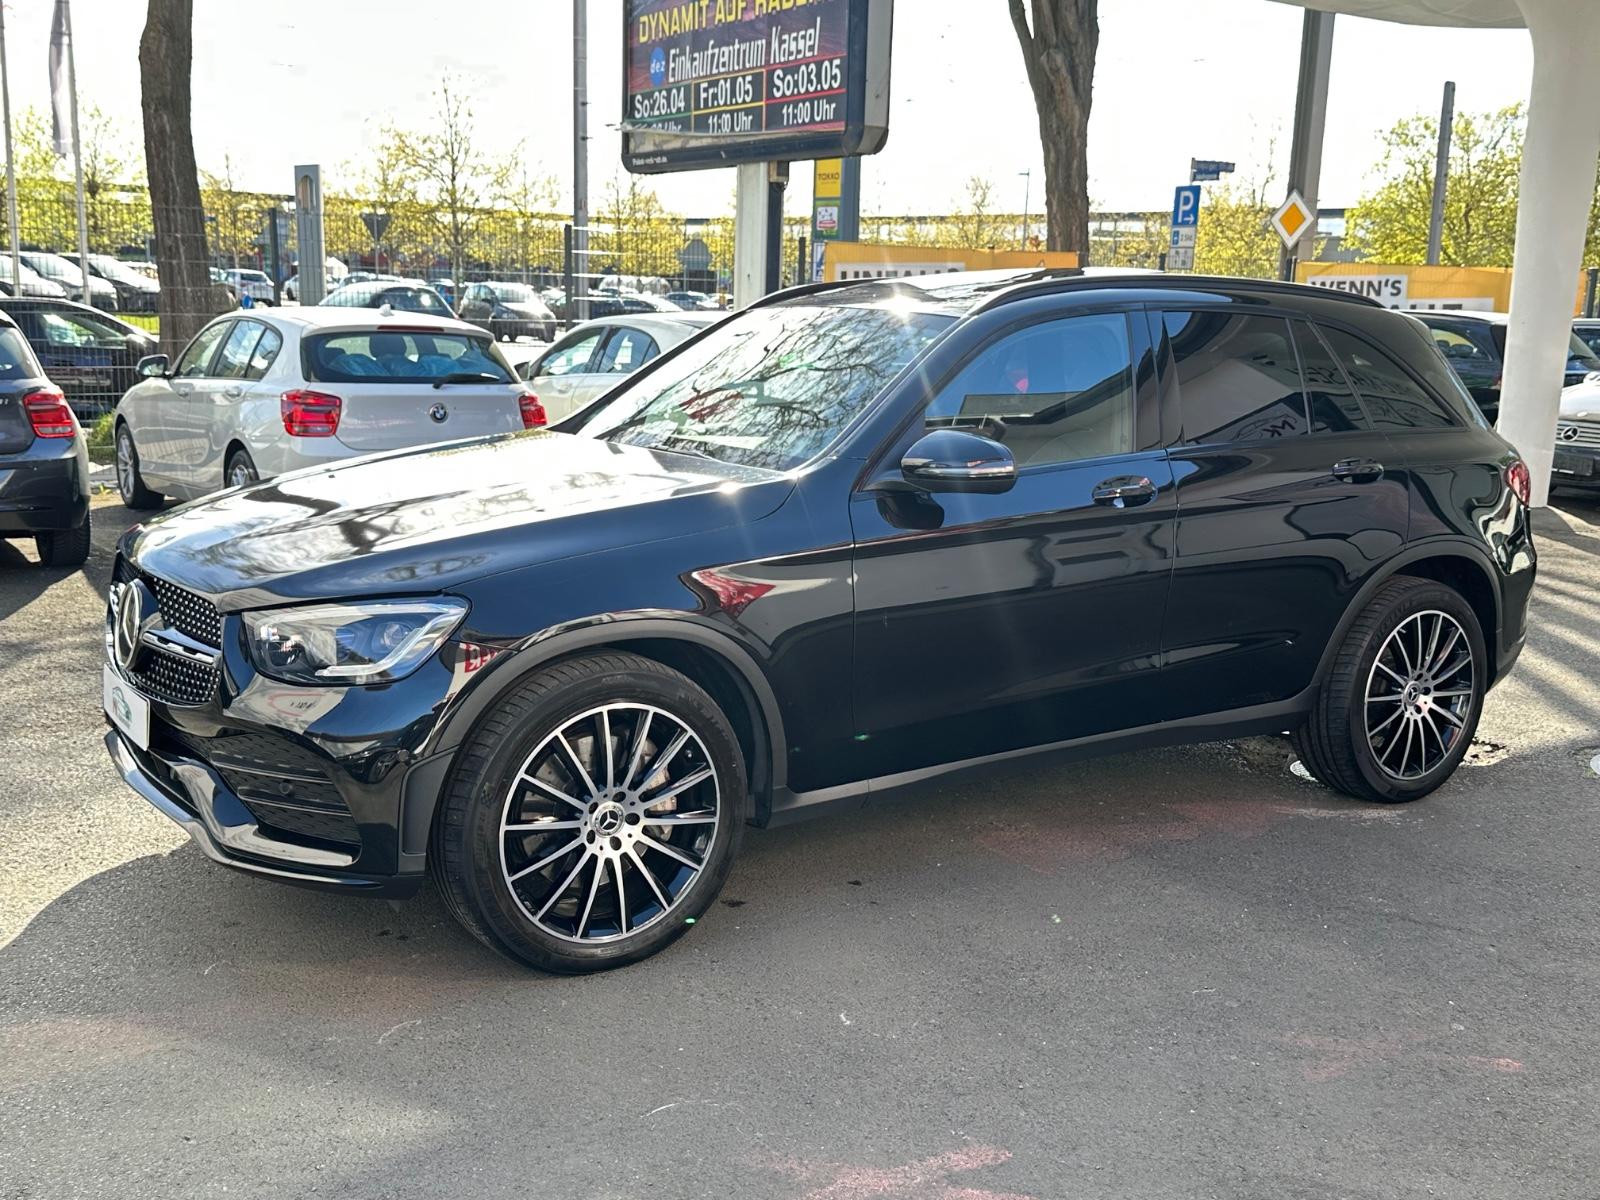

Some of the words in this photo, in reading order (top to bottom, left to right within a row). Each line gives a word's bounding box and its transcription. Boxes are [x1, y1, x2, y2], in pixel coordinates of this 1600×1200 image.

[639, 0, 708, 43] DYNAMIT
[715, 0, 747, 25] AUF
[668, 38, 767, 82] Einkaufzentrum
[770, 16, 821, 64] Kassel
[650, 58, 666, 74] dez
[772, 58, 841, 98] So:03.05
[634, 86, 686, 119] So:26.04
[700, 74, 753, 109] Fr:01.05
[708, 112, 732, 134] 11:00
[734, 111, 753, 132] Uhr
[782, 101, 811, 126] 11:00
[814, 98, 837, 121] Uhr
[1177, 190, 1194, 223] P
